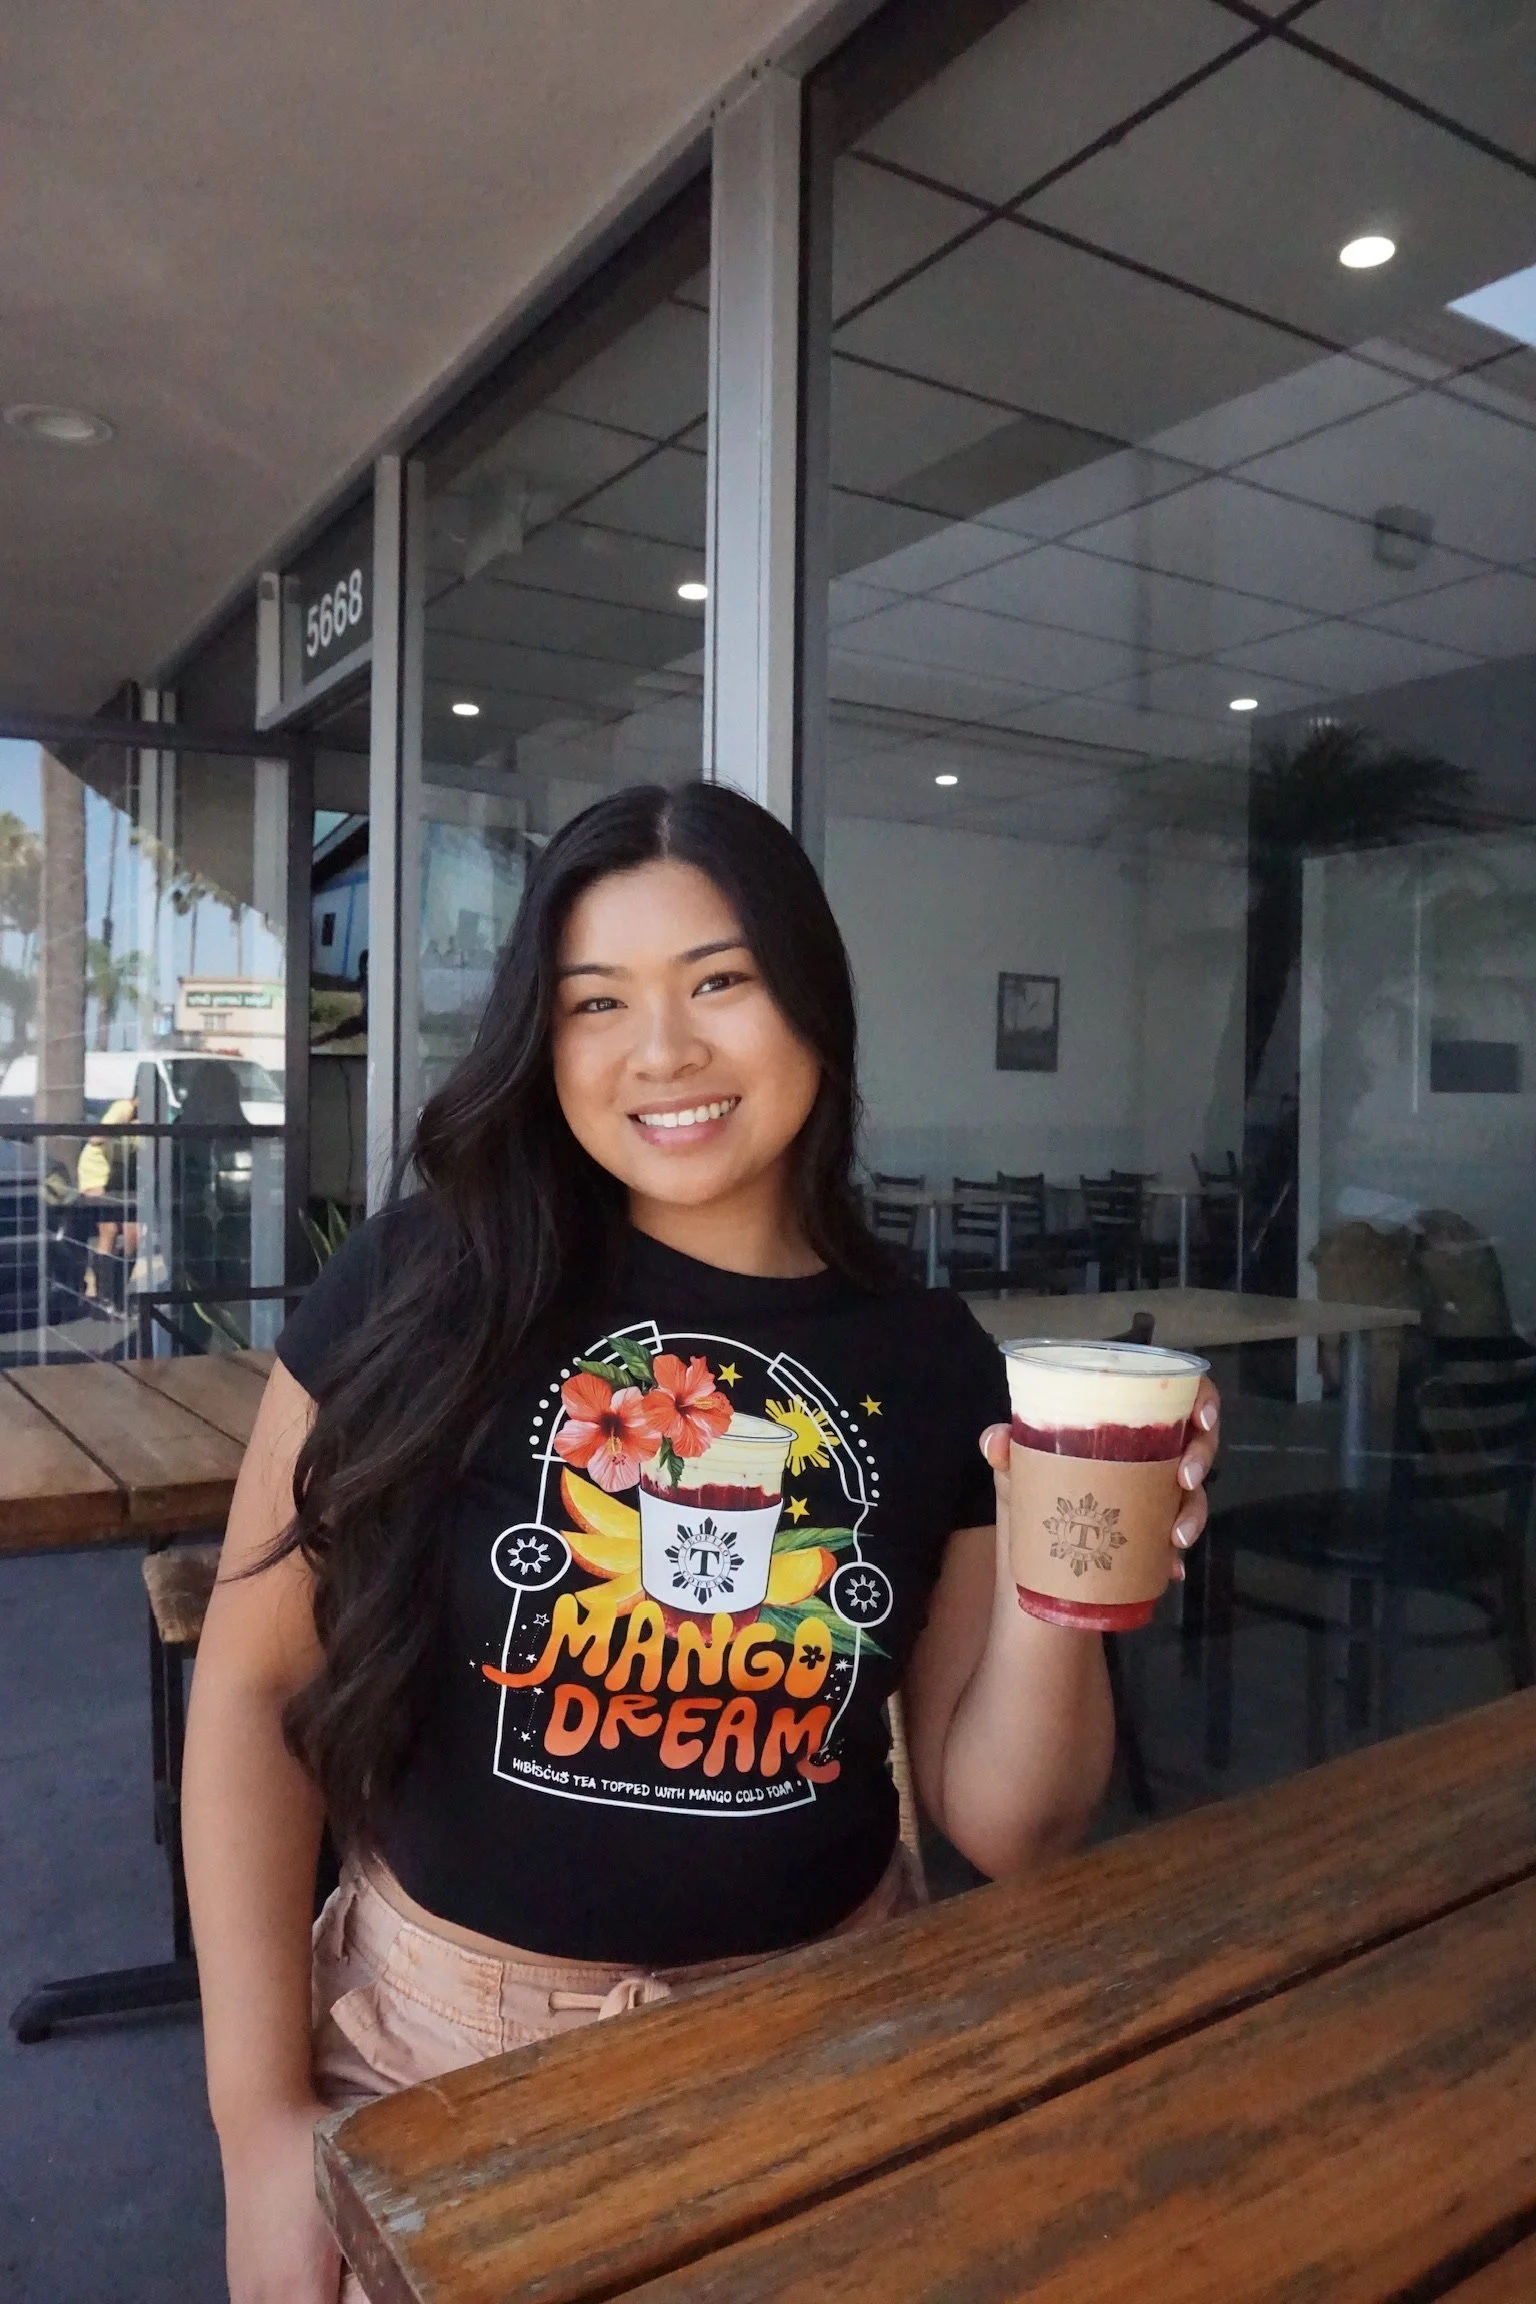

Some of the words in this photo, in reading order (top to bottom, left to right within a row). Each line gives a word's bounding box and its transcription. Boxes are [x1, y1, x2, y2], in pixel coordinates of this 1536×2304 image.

[306, 568, 363, 658] 5668
[690, 1548, 720, 1577] T
[1069, 1521, 1099, 1550] T
[482, 1593, 833, 1699] MANGO
[543, 1683, 841, 1783] DREAM
[573, 1774, 597, 1790] TEA
[601, 1779, 651, 1797] TOPPED
[654, 1785, 686, 1800] WITH
[688, 1788, 732, 1804] MANGO
[735, 1787, 765, 1804] COLD
[766, 1780, 794, 1799] FOAM
